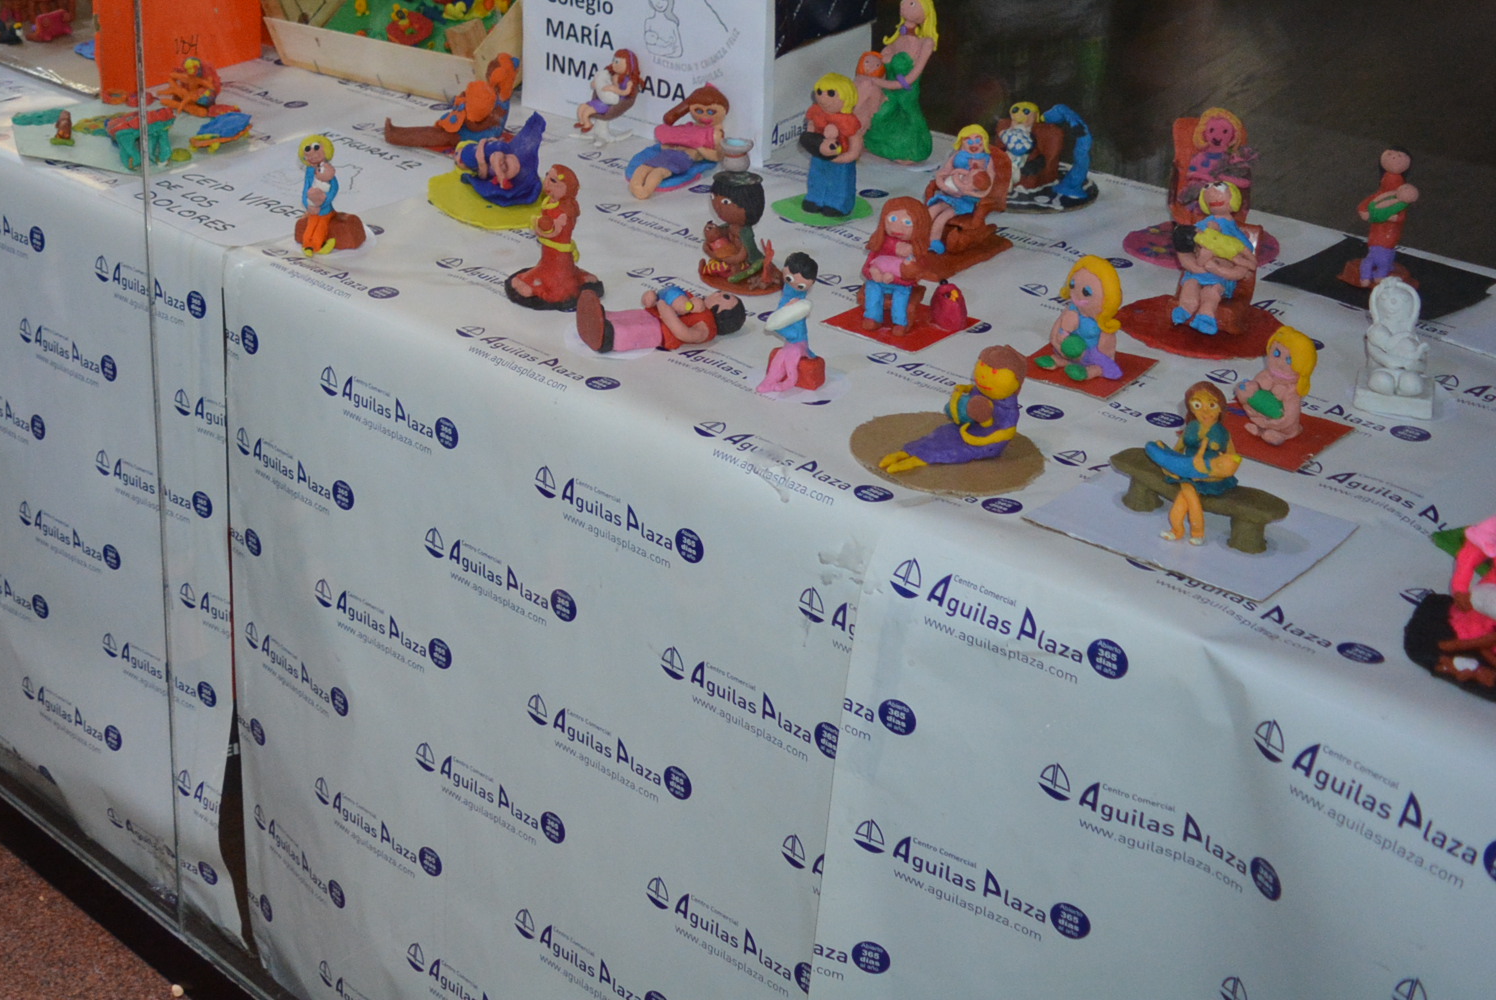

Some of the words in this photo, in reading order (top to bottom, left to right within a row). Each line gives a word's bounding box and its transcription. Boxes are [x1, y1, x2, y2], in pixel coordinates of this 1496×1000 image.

[546, 18, 613, 50] MARÍA
[546, 52, 686, 101] INMAADA
[338, 136, 399, 163] FIGURAS
[155, 180, 181, 191] DE
[181, 192, 221, 208] LOS
[182, 174, 234, 193] CEIP
[2, 215, 29, 246] Plaza
[133, 190, 236, 233] DOLORES
[619, 210, 670, 234] Aguilas
[672, 228, 704, 244] Plaz
[1051, 240, 1088, 258] Plaz
[112, 262, 150, 298] Aguilas
[154, 277, 186, 312] Plaza
[333, 270, 368, 293] Plaza
[458, 263, 508, 287] Aguila
[35, 324, 70, 361] Aguilas
[72, 341, 101, 374] Plaza
[225, 328, 240, 346] aza
[480, 336, 538, 364] Aguilas
[539, 357, 584, 384] Plaza
[468, 344, 567, 392] www.aguilasplaza.com
[678, 349, 742, 378] Aguilas
[897, 362, 956, 387] Aguila
[5, 400, 30, 432] Plaza
[195, 396, 228, 428] Aguil
[342, 375, 391, 419] Aguilas
[395, 397, 433, 439] Plaza
[1108, 401, 1143, 418] aza
[1324, 403, 1386, 432] Plaza
[342, 409, 432, 455] www.aguilasplaza.com
[113, 458, 156, 495] Aguilas
[253, 438, 294, 481] Aguilas
[297, 460, 331, 501] Plaza
[796, 460, 852, 492] Plaza
[1326, 472, 1415, 511] Aguilas
[35, 509, 70, 546] Aguilas
[72, 528, 103, 562] Plaza
[229, 527, 245, 546] aza
[562, 477, 622, 526] Aguilas
[626, 504, 673, 551] Plaza
[563, 511, 671, 569] www.aguilasplaza.com
[4, 579, 33, 611] Plaza
[449, 539, 502, 587] Aguilas
[506, 564, 549, 610] Plaza
[953, 574, 978, 591] Centro
[979, 585, 1017, 608] Comercial
[200, 592, 232, 623] Agui
[450, 570, 548, 628] www.aguilasplaza.com
[927, 573, 1012, 637] Aguilas
[1016, 606, 1083, 664] Plaza
[336, 589, 386, 636] Aguilas
[389, 614, 428, 659] Plaza
[1260, 604, 1332, 649] Plaza
[121, 642, 163, 681] Aguilas
[262, 634, 299, 682] Aguilas
[301, 661, 331, 704] Plaza
[923, 614, 1079, 685] www.aguilasplaza.com
[1097, 649, 1118, 662] 365
[37, 686, 73, 724] Aguilas
[74, 706, 103, 743] Plaza
[691, 660, 756, 715] Aguilas
[762, 691, 812, 744] Plaza
[843, 697, 875, 724] aza
[887, 708, 906, 720] 365
[553, 707, 612, 759] Aguilas
[616, 737, 662, 786] Plaza
[692, 694, 808, 763] www.aguilasplaza.com
[440, 755, 494, 804] Aguilas
[498, 783, 539, 831] Plaza
[553, 738, 659, 803] www.aguilasplaza.com
[193, 780, 220, 815] Agui
[441, 785, 537, 847] www.aguilasplaza.com
[1102, 782, 1131, 798] Centro
[1132, 793, 1176, 814] Comercial
[1292, 743, 1392, 821] Aguilas
[1398, 791, 1478, 867] Plaza
[333, 791, 377, 840] Aguilas
[381, 821, 417, 865] Plaza
[1078, 782, 1175, 838] Aguilas
[1183, 812, 1248, 877] Plaza
[1289, 783, 1465, 889] www.aguilasplaza.com
[268, 819, 301, 868] Aguilas
[302, 850, 328, 895] Plaza
[913, 837, 937, 853] Centro
[939, 848, 977, 870] Comercial
[1078, 817, 1244, 894] www.aguilasplaza.com
[892, 836, 976, 894] Aguilas
[983, 868, 1046, 924] Plaza
[893, 868, 1042, 943] www.aguilasplaza.com
[675, 892, 739, 949] Aguilas
[743, 928, 792, 982] Plaza
[813, 943, 849, 965] aza
[540, 924, 595, 978] Aguilas
[598, 958, 642, 1000] Plaza
[674, 924, 790, 998] www.aguilasplaza.com
